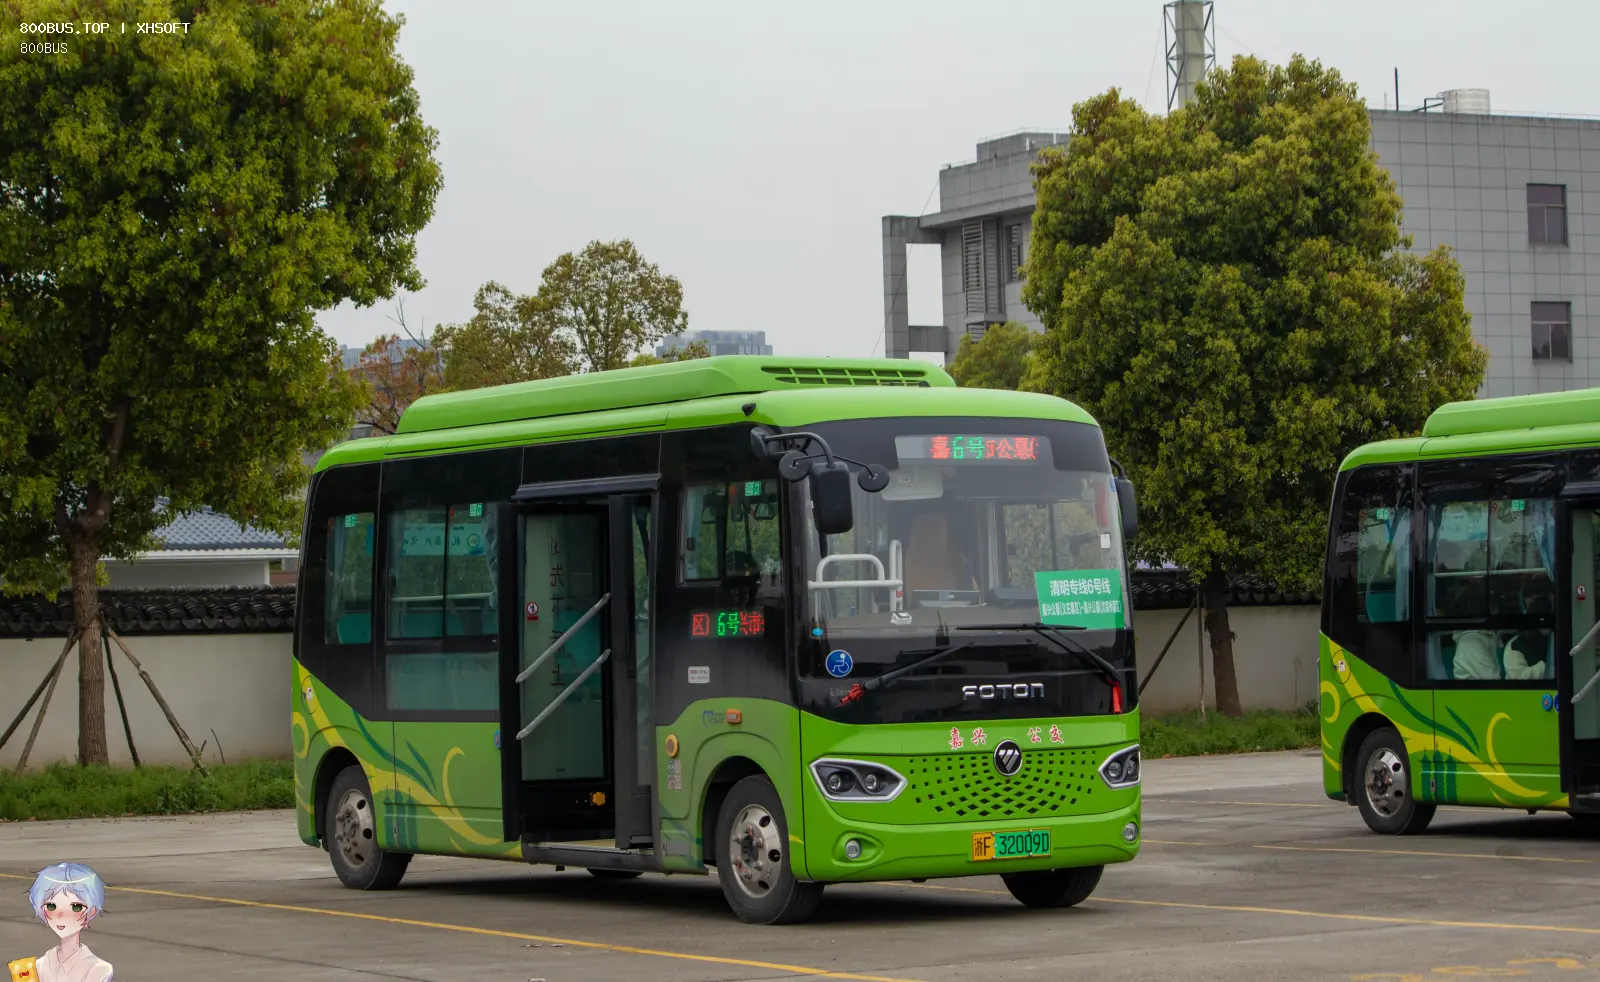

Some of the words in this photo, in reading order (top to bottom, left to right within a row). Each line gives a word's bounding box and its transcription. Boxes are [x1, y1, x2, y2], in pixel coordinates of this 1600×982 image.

[1049, 578, 1111, 596] 清明专线6号线
